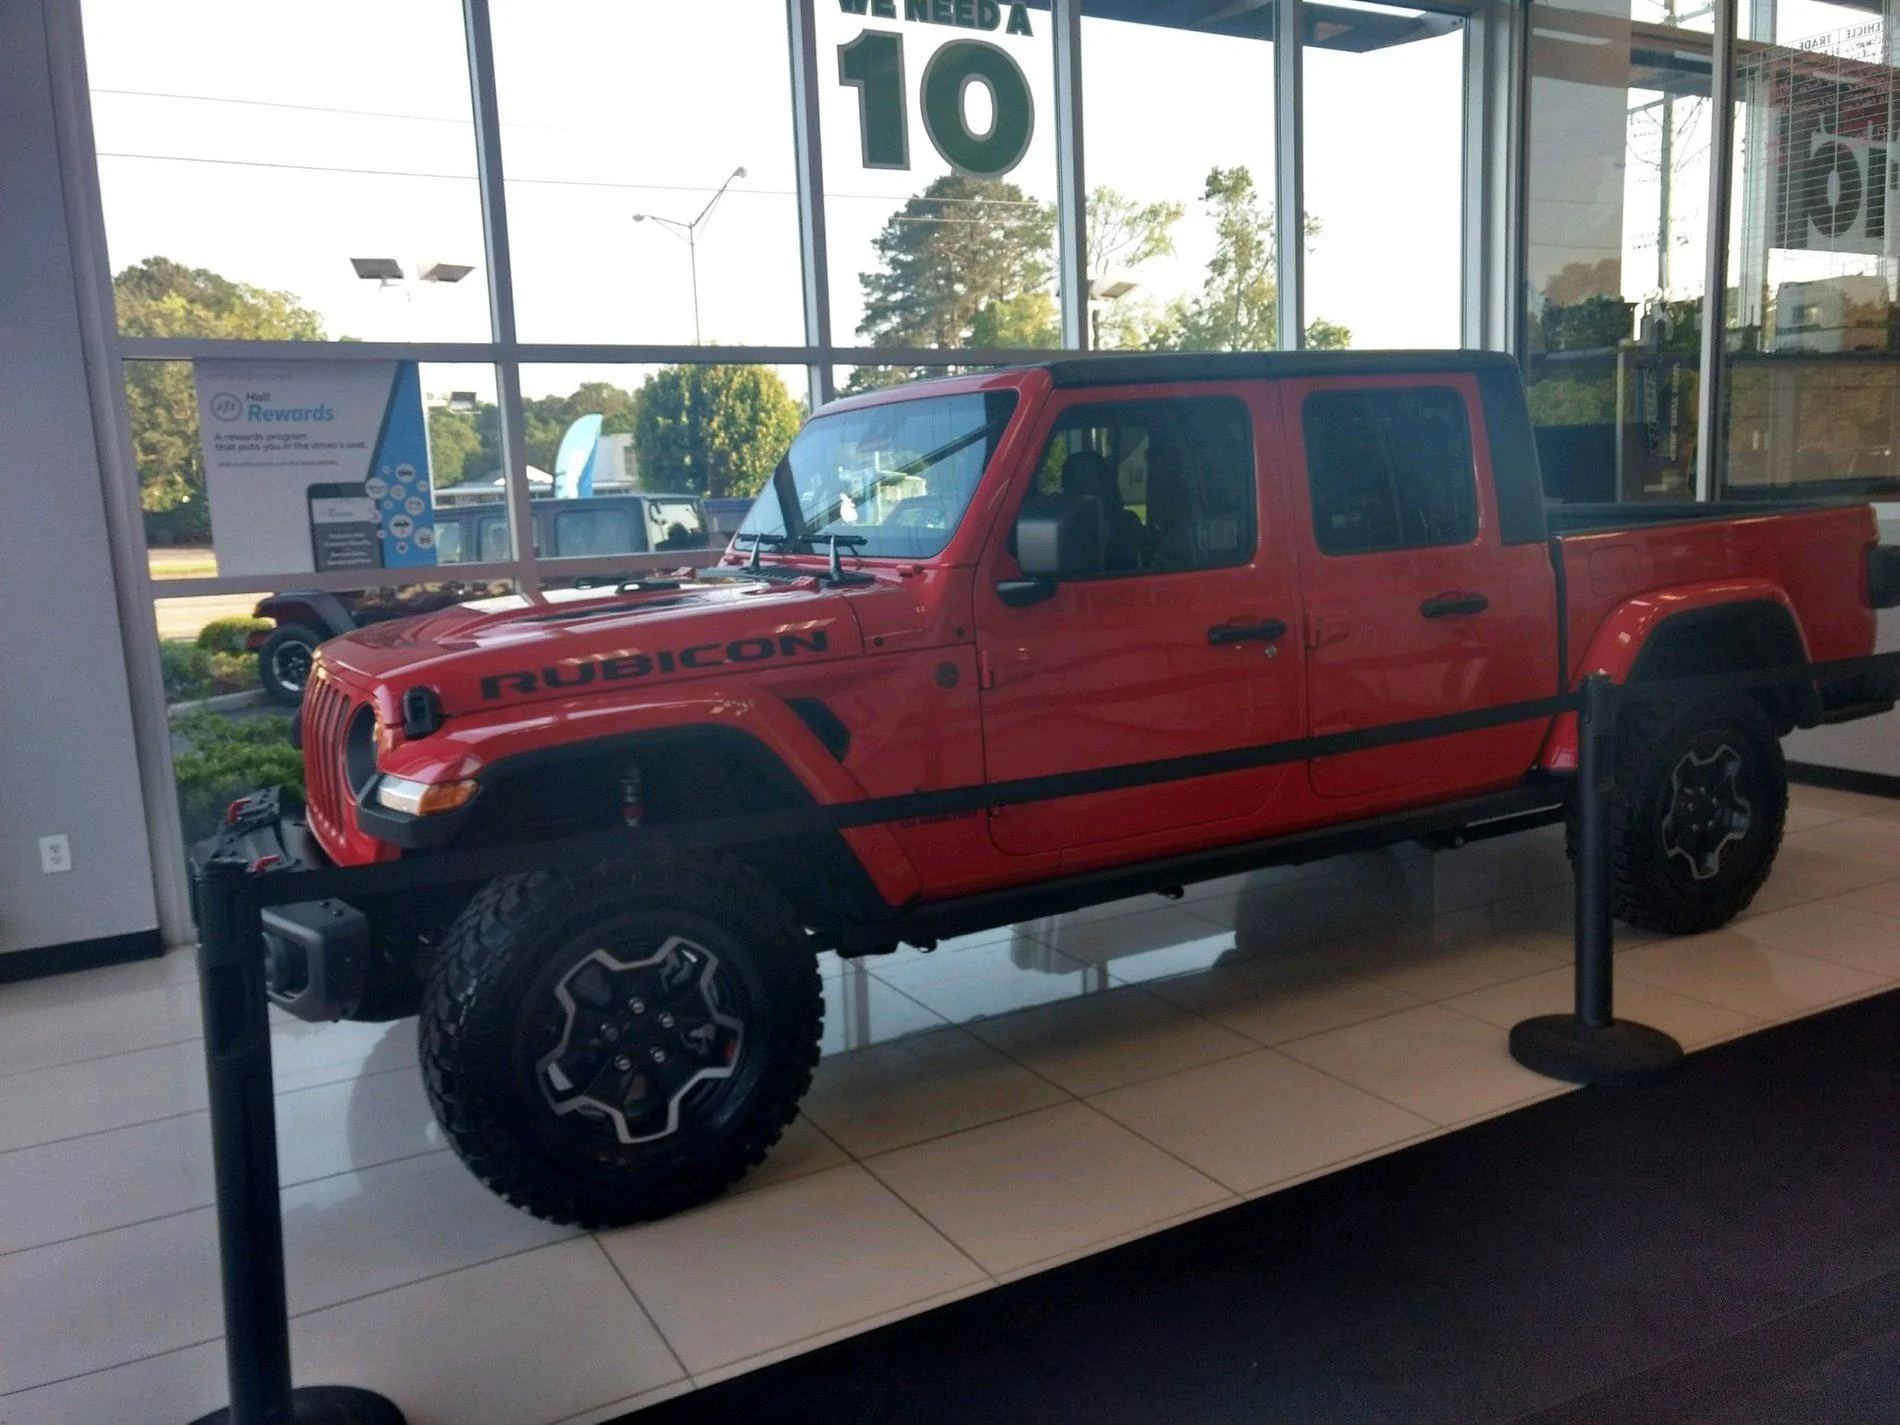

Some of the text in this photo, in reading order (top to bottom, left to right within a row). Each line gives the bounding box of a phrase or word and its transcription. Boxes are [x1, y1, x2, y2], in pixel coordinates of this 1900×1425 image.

[905, 0, 1001, 31] NEED
[1006, 2, 1034, 37] A
[837, 29, 1035, 177] 10
[245, 392, 270, 402] Hall
[247, 404, 334, 422] Rewards
[224, 433, 264, 441] rewards
[266, 433, 308, 442] program
[481, 631, 828, 701] RUBICON
